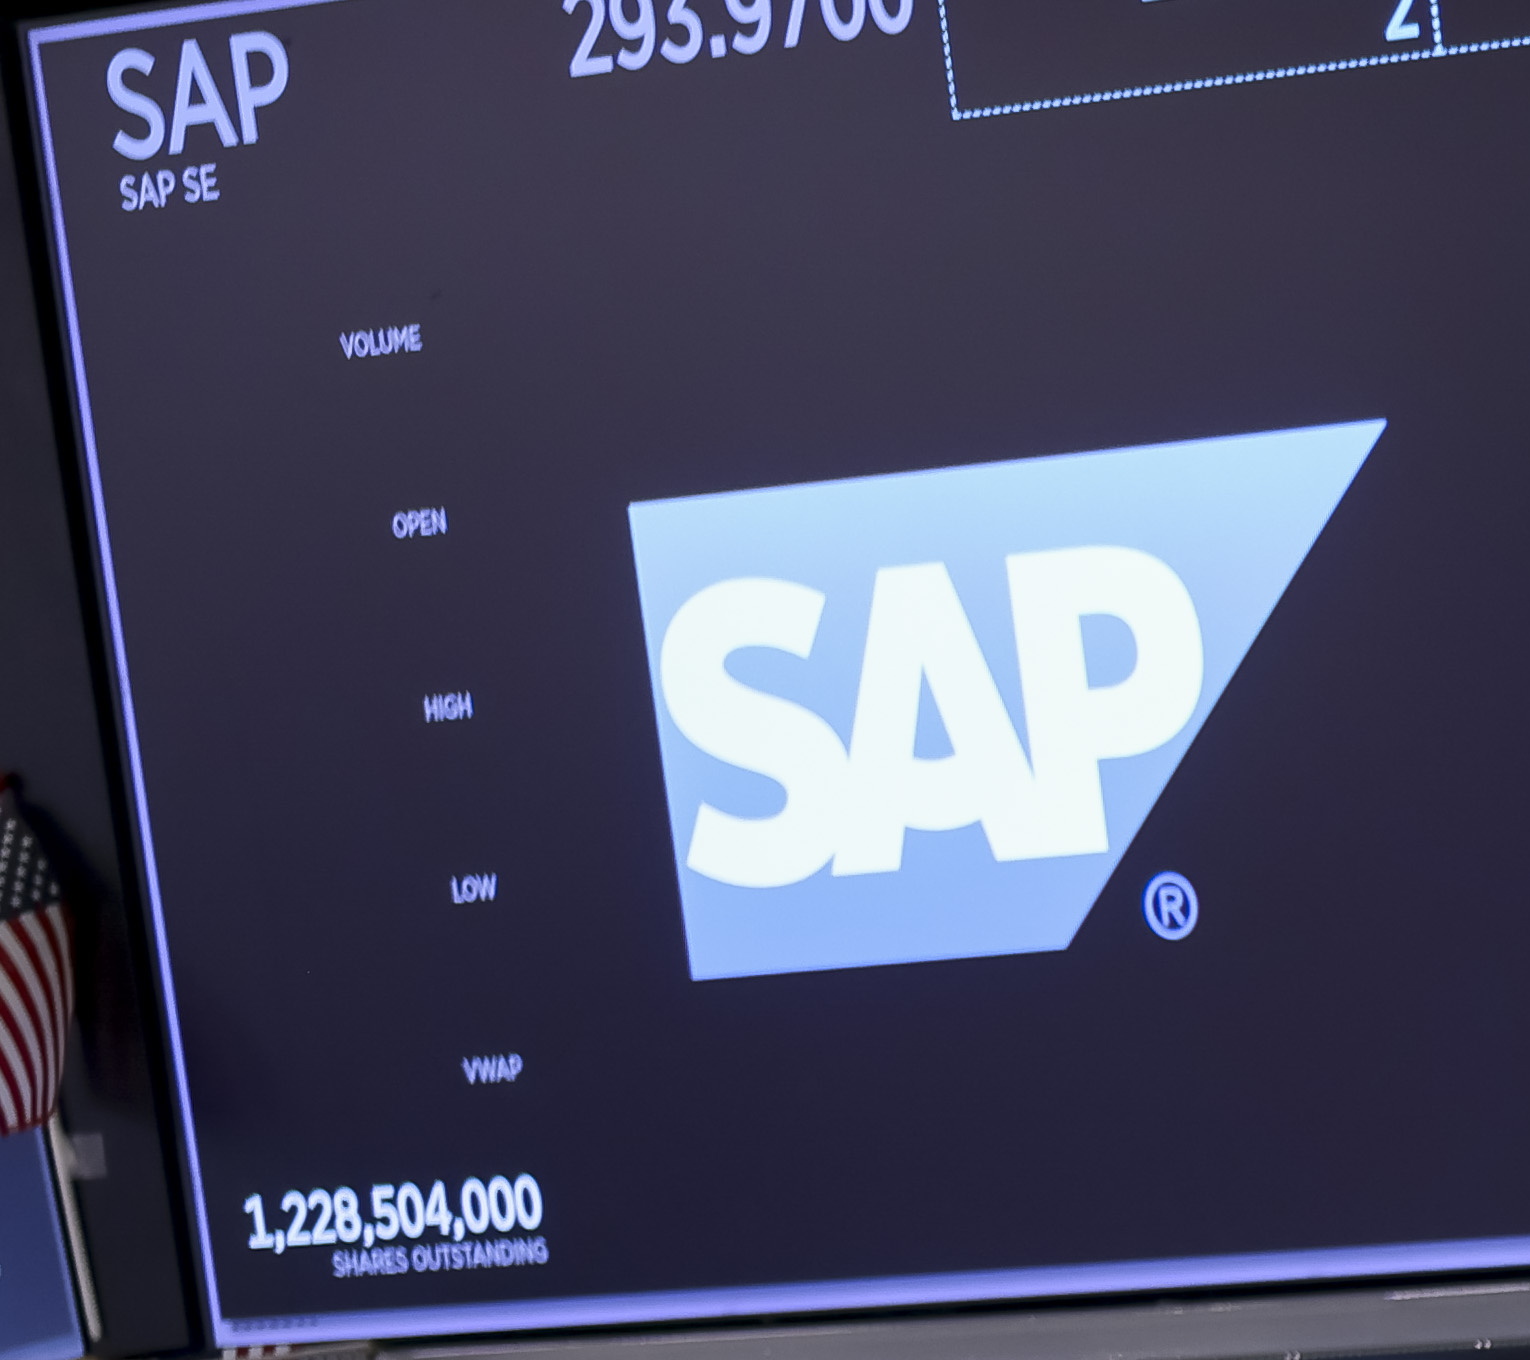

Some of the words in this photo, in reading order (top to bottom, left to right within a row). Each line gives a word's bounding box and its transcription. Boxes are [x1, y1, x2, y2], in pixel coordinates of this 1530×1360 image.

[106, 31, 289, 161] SAP
[119, 170, 176, 212] SAP
[182, 163, 220, 203] SE
[340, 323, 423, 359] VOLUME
[392, 507, 447, 539] OPEN
[424, 691, 473, 723] HIGH
[660, 544, 1204, 889] SAP
[452, 873, 497, 904] LOW
[462, 1053, 523, 1085] VWAP
[243, 1173, 543, 1255] 1,228,504,000
[332, 1247, 409, 1278] SHARES
[412, 1235, 549, 1272] OUTSTANDING
